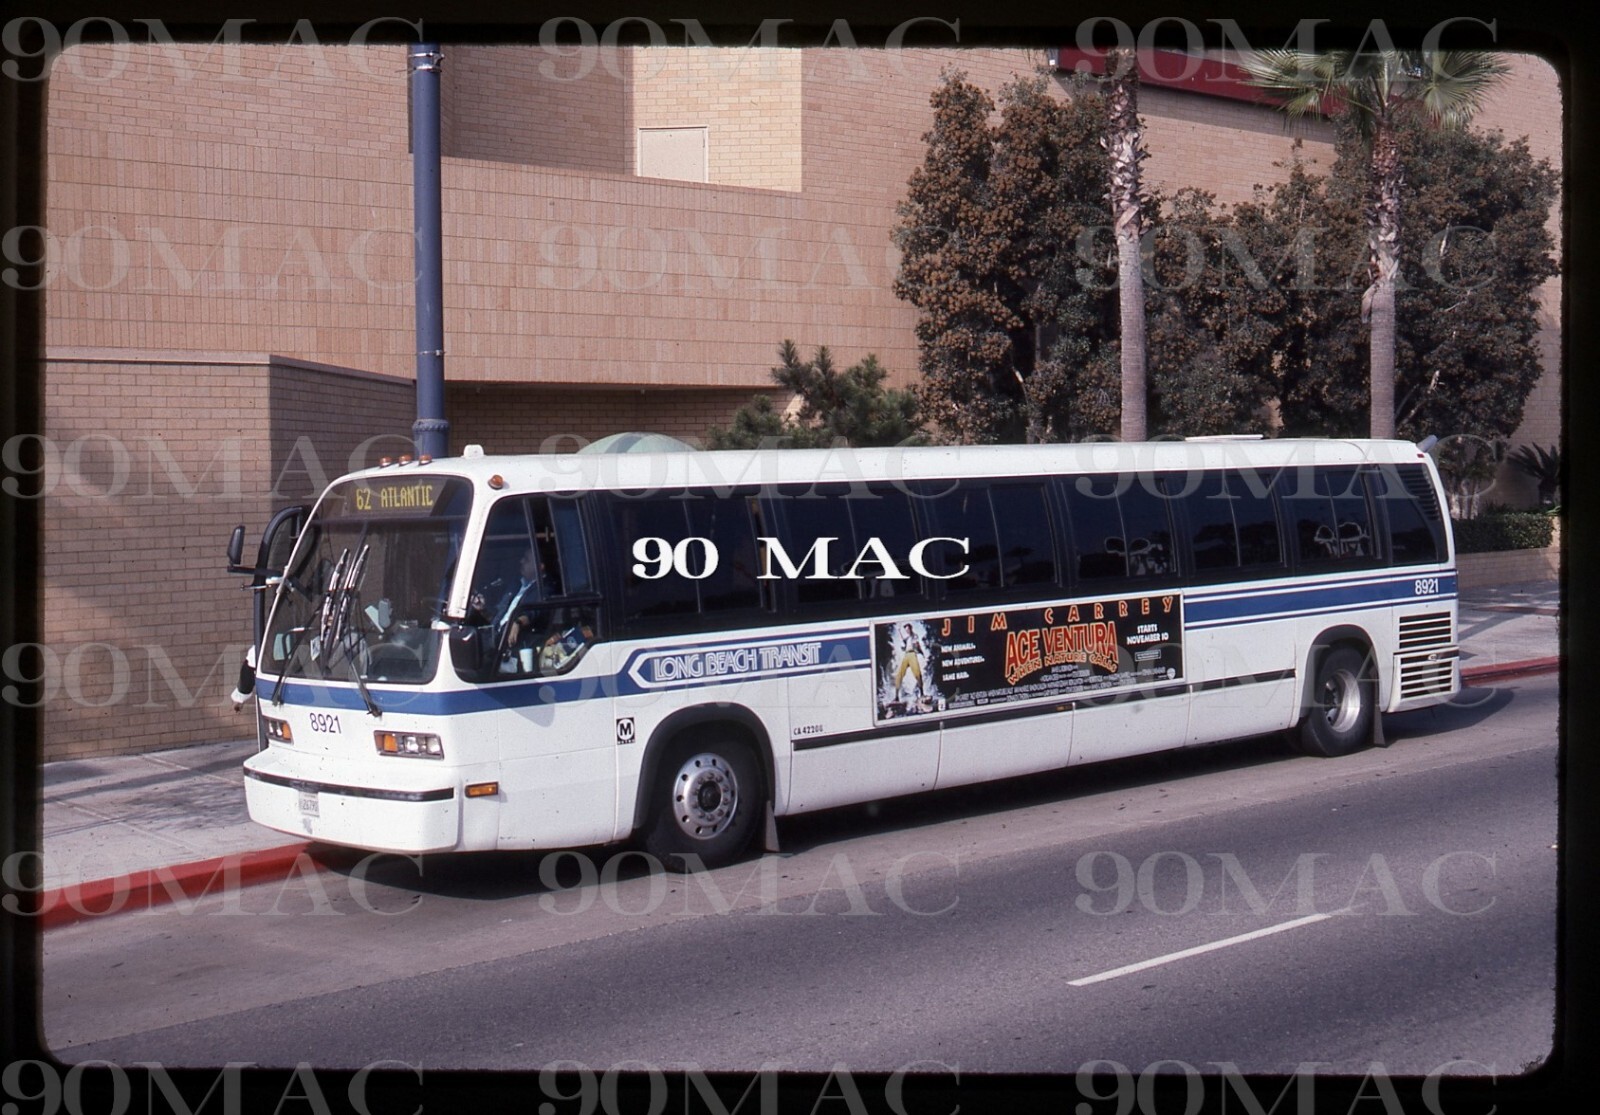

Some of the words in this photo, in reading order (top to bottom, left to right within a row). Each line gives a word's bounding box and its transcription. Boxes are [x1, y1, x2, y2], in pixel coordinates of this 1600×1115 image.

[356, 488, 371, 510] 62
[381, 485, 434, 507] ATLANTIC
[1415, 578, 1439, 595] 8921
[942, 612, 1007, 636] JIM
[1045, 596, 1173, 624] CARREY
[1137, 623, 1158, 634] STARTS
[1005, 629, 1041, 678] ACE
[1042, 621, 1119, 663] VENTURA
[1126, 634, 1160, 645] NOVEMBER
[654, 652, 704, 681] LONG
[706, 648, 757, 676] BEACH
[759, 642, 822, 669] TRANSIT
[1007, 659, 1042, 685] WHEN
[1044, 652, 1087, 666] NATURE
[1089, 653, 1118, 673] CALLS
[309, 712, 342, 734] 8921
